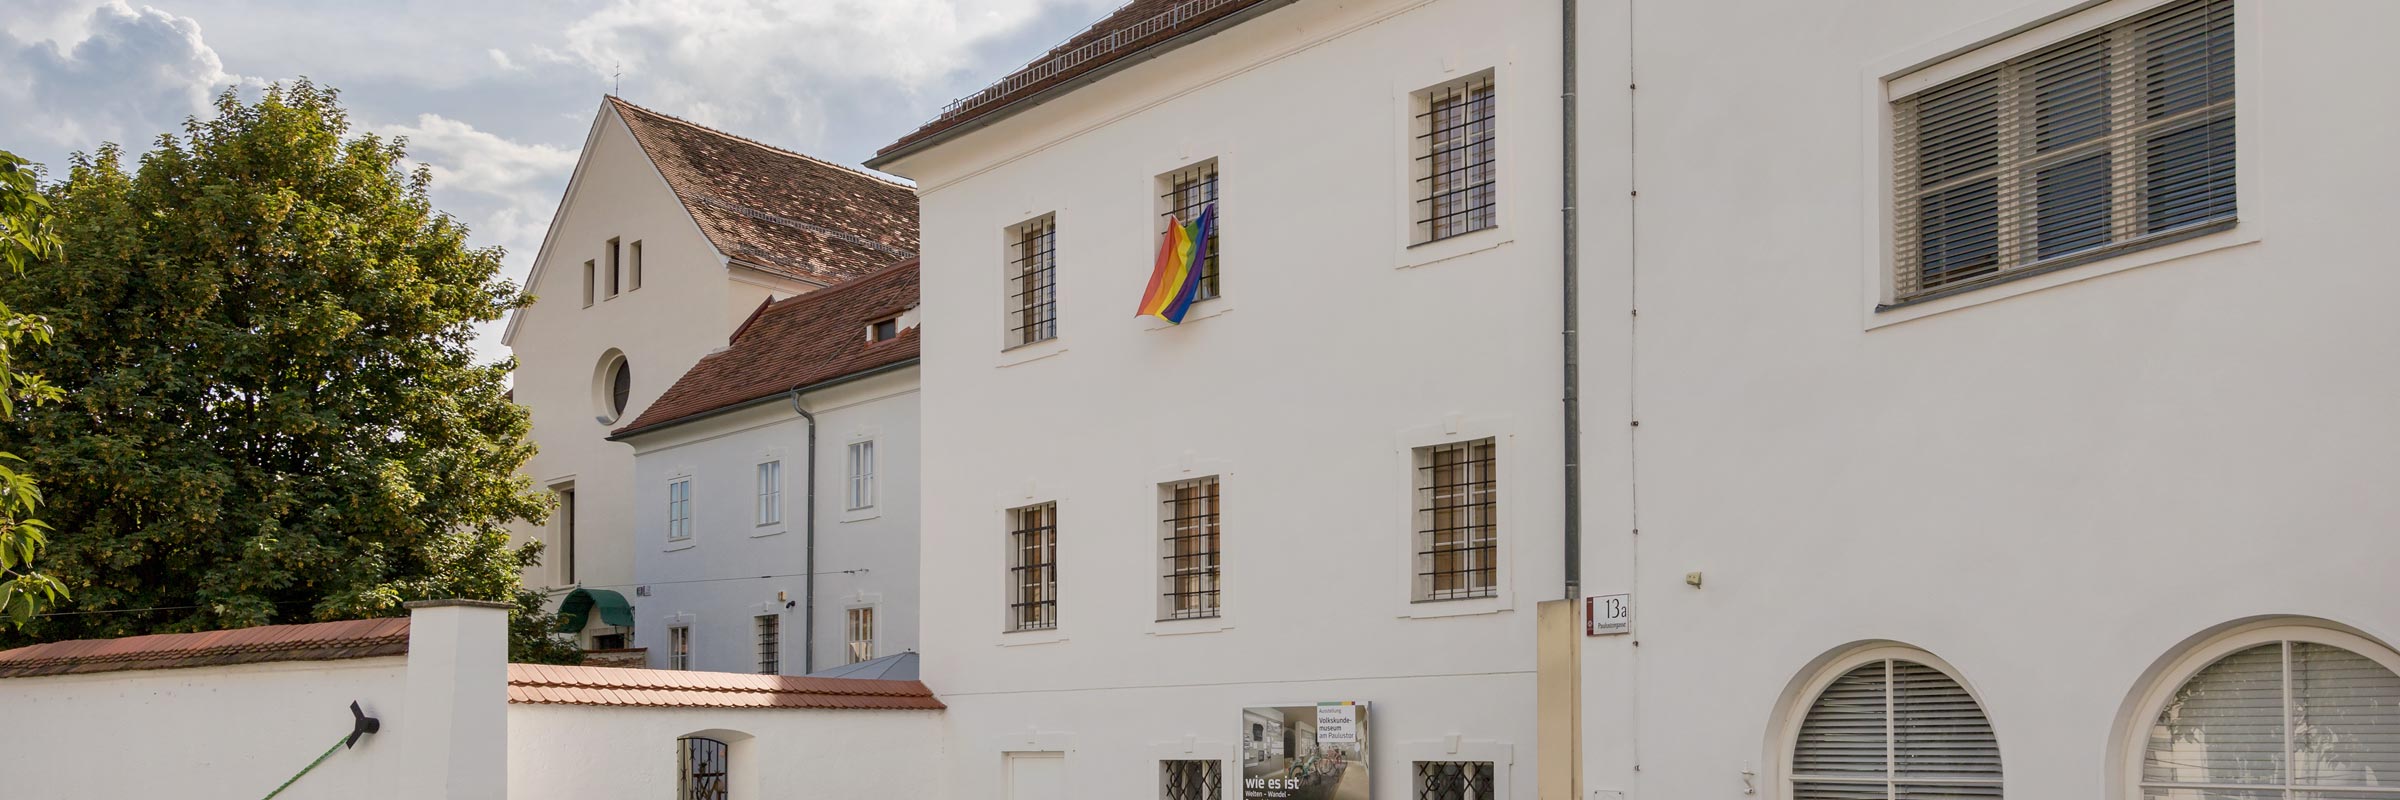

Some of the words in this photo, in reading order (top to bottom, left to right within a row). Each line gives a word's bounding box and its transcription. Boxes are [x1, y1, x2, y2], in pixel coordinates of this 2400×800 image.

[1606, 598, 1627, 619] 13a
[1245, 775, 1264, 789] wie
[1268, 778, 1281, 789] es
[1284, 775, 1299, 790] ist
[1268, 790, 1287, 798] Wandel
